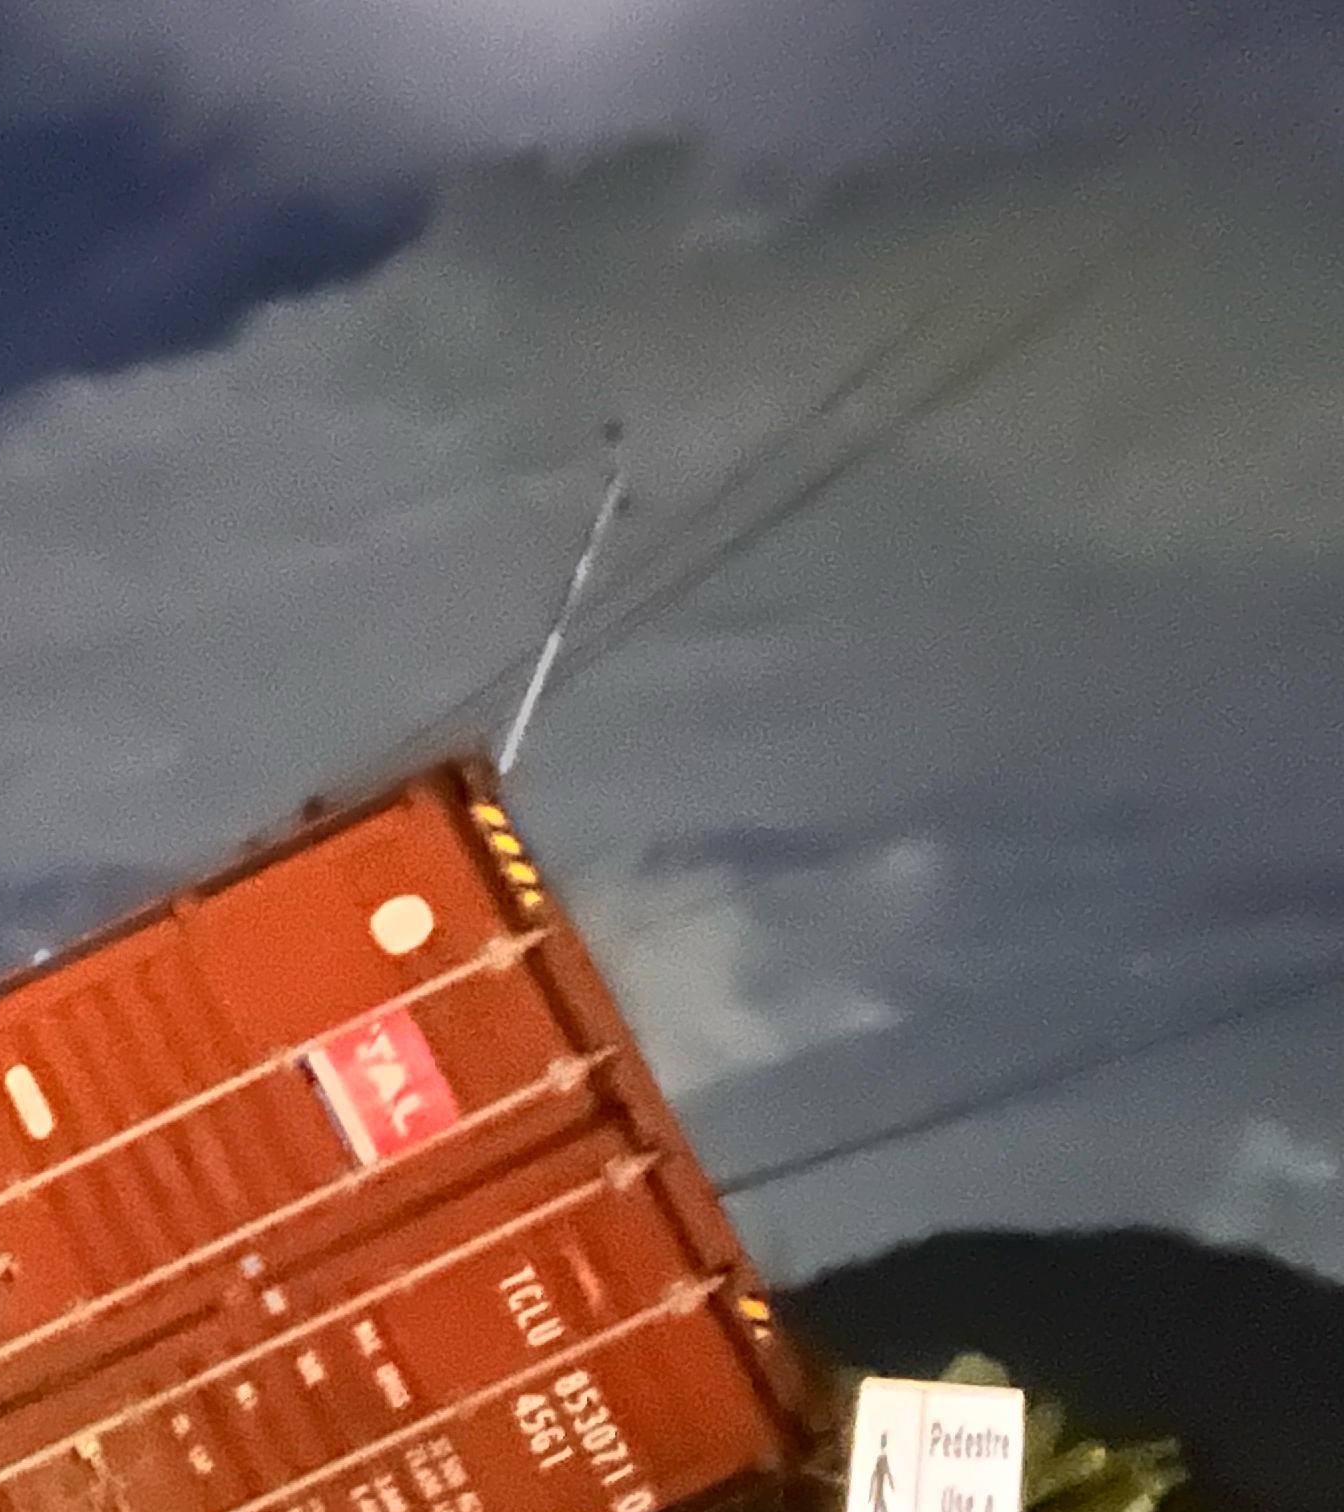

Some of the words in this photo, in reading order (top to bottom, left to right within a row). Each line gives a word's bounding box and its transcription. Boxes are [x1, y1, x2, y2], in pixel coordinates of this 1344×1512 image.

[499, 1265, 565, 1348] TCLU
[552, 1368, 635, 1487] 853071
[512, 1393, 574, 1471] 4561
[929, 1422, 1010, 1460] Pedestre
